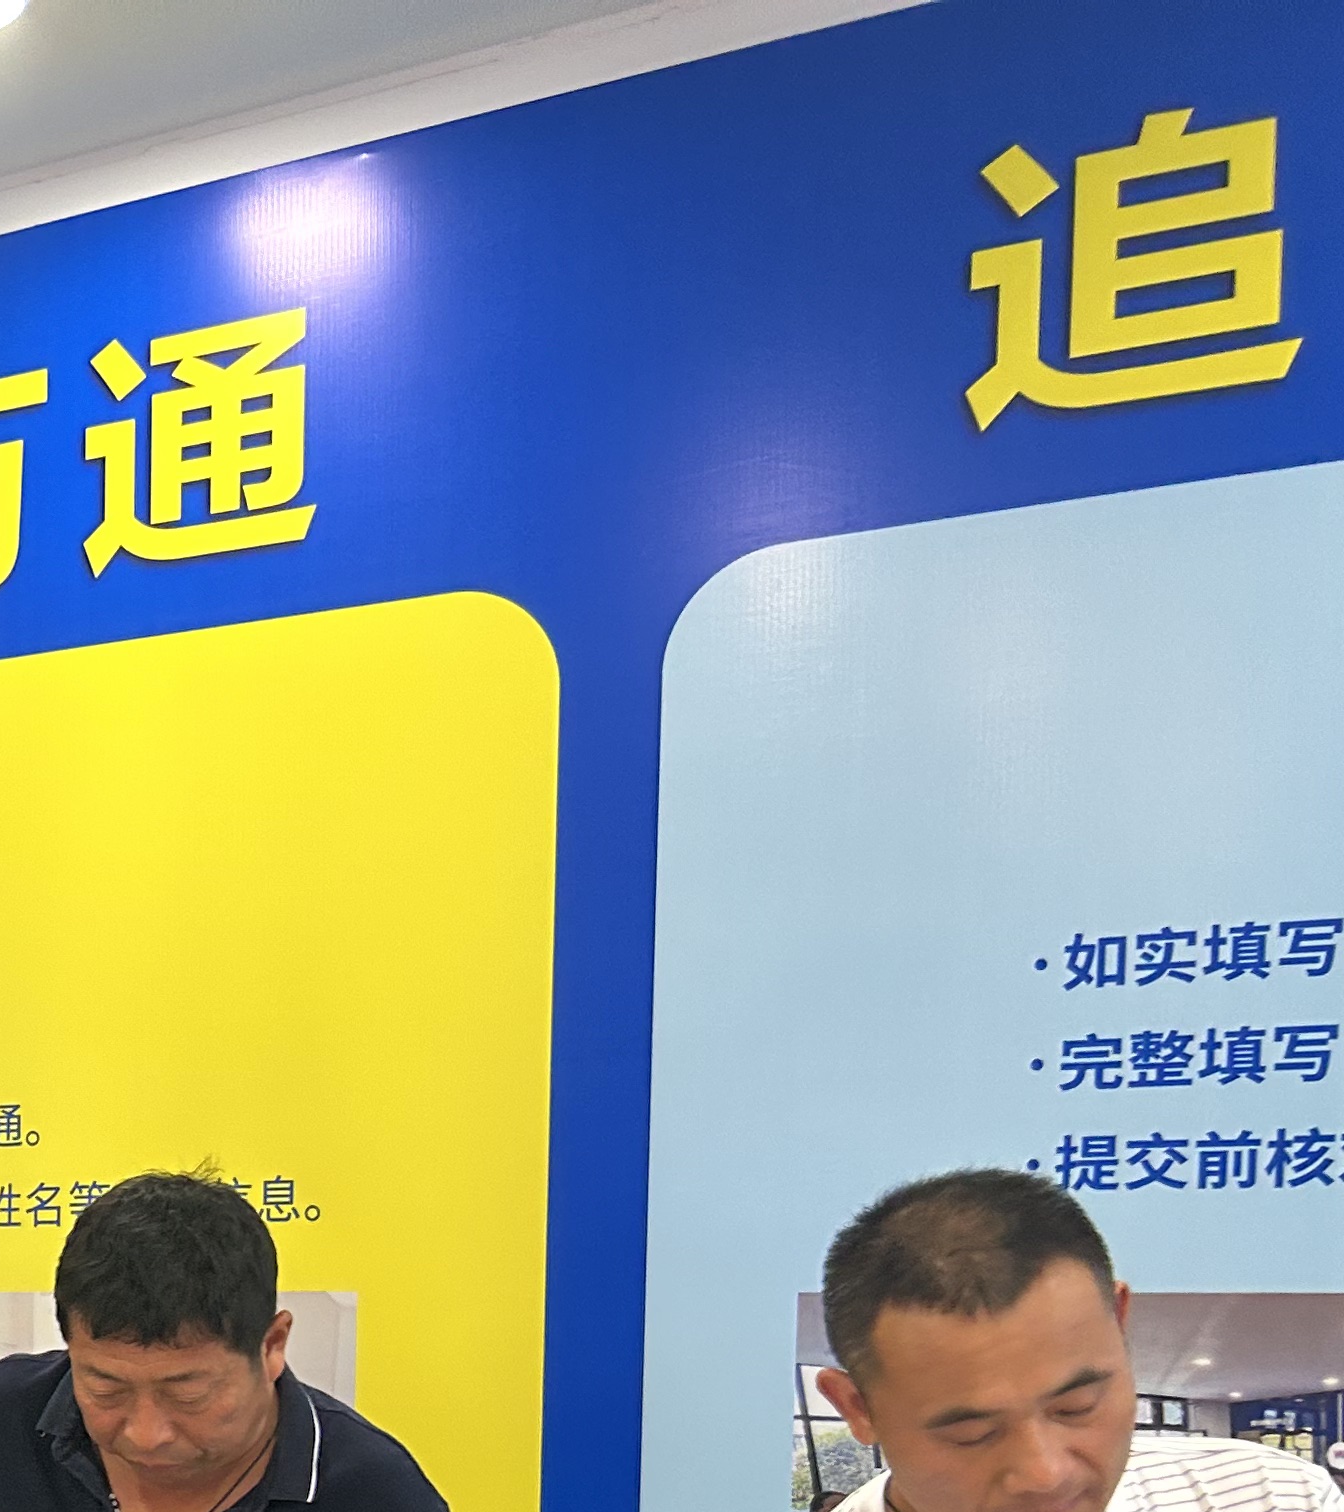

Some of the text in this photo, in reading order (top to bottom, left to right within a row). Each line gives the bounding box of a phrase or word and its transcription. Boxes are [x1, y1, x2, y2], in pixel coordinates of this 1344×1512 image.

[965, 106, 1304, 433] 追
[1026, 1127, 1344, 1192] ·提交前核
